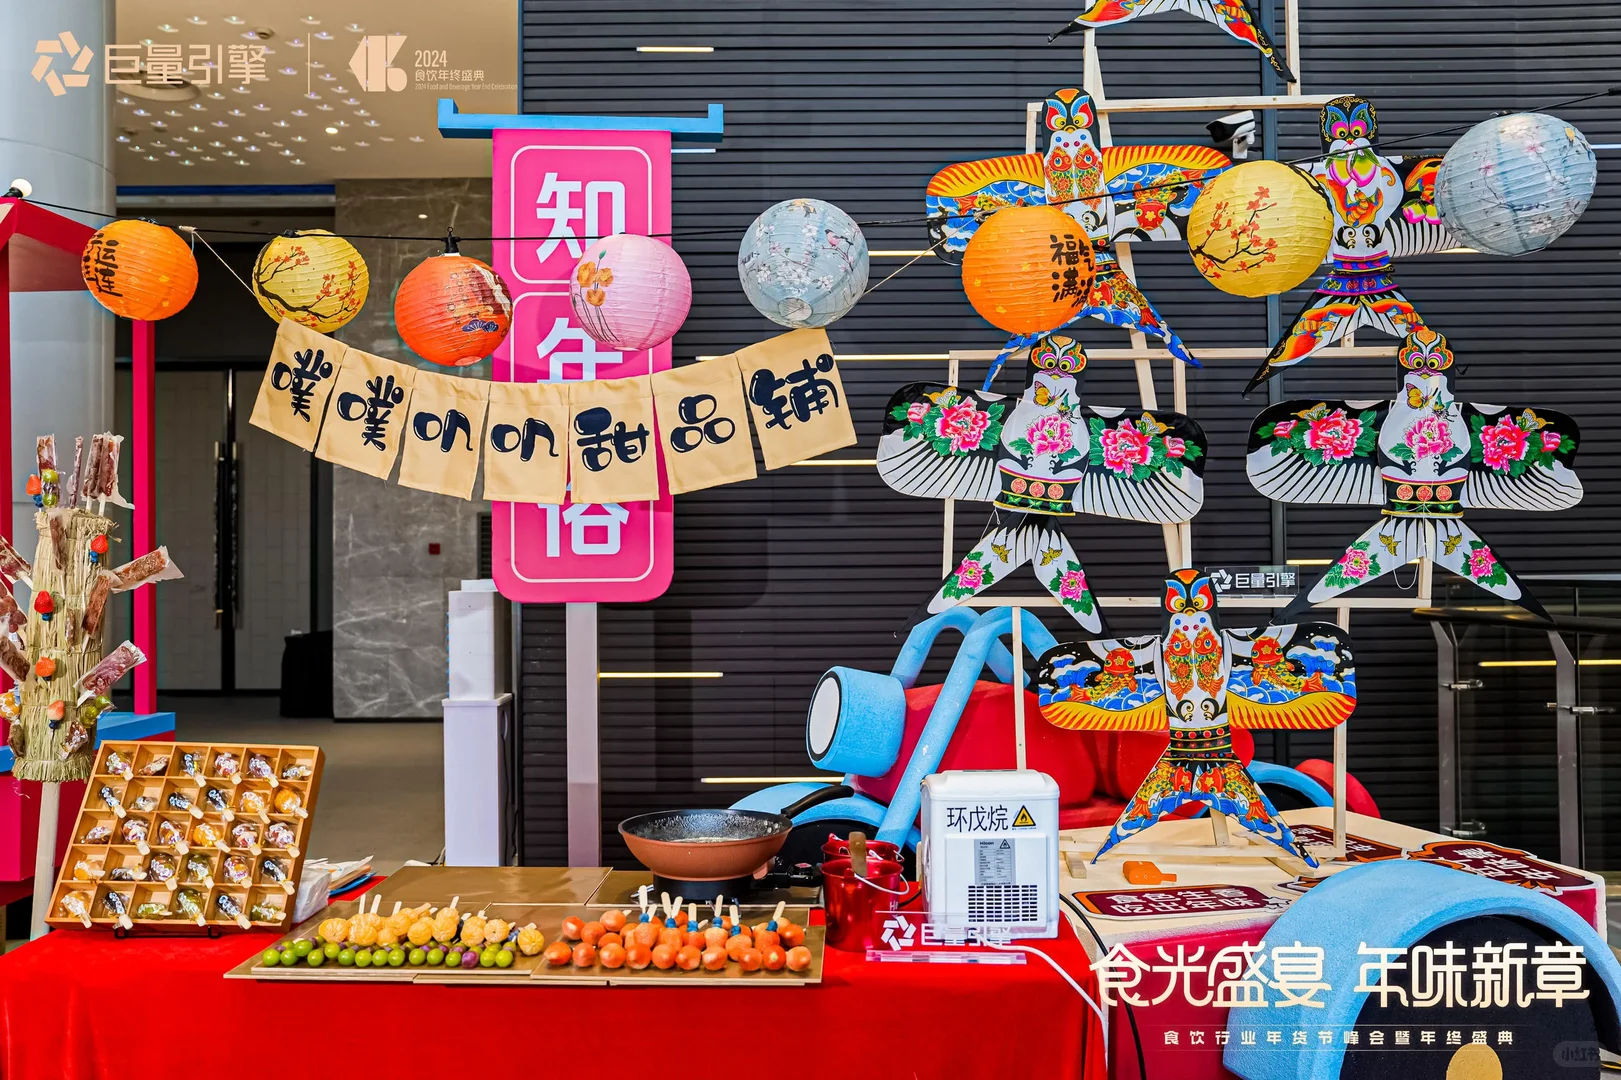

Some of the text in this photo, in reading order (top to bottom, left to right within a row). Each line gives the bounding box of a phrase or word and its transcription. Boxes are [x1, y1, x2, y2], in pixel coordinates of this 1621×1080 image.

[1235, 572, 1296, 589] 巨量引擎
[946, 804, 1009, 833] 环戊烷
